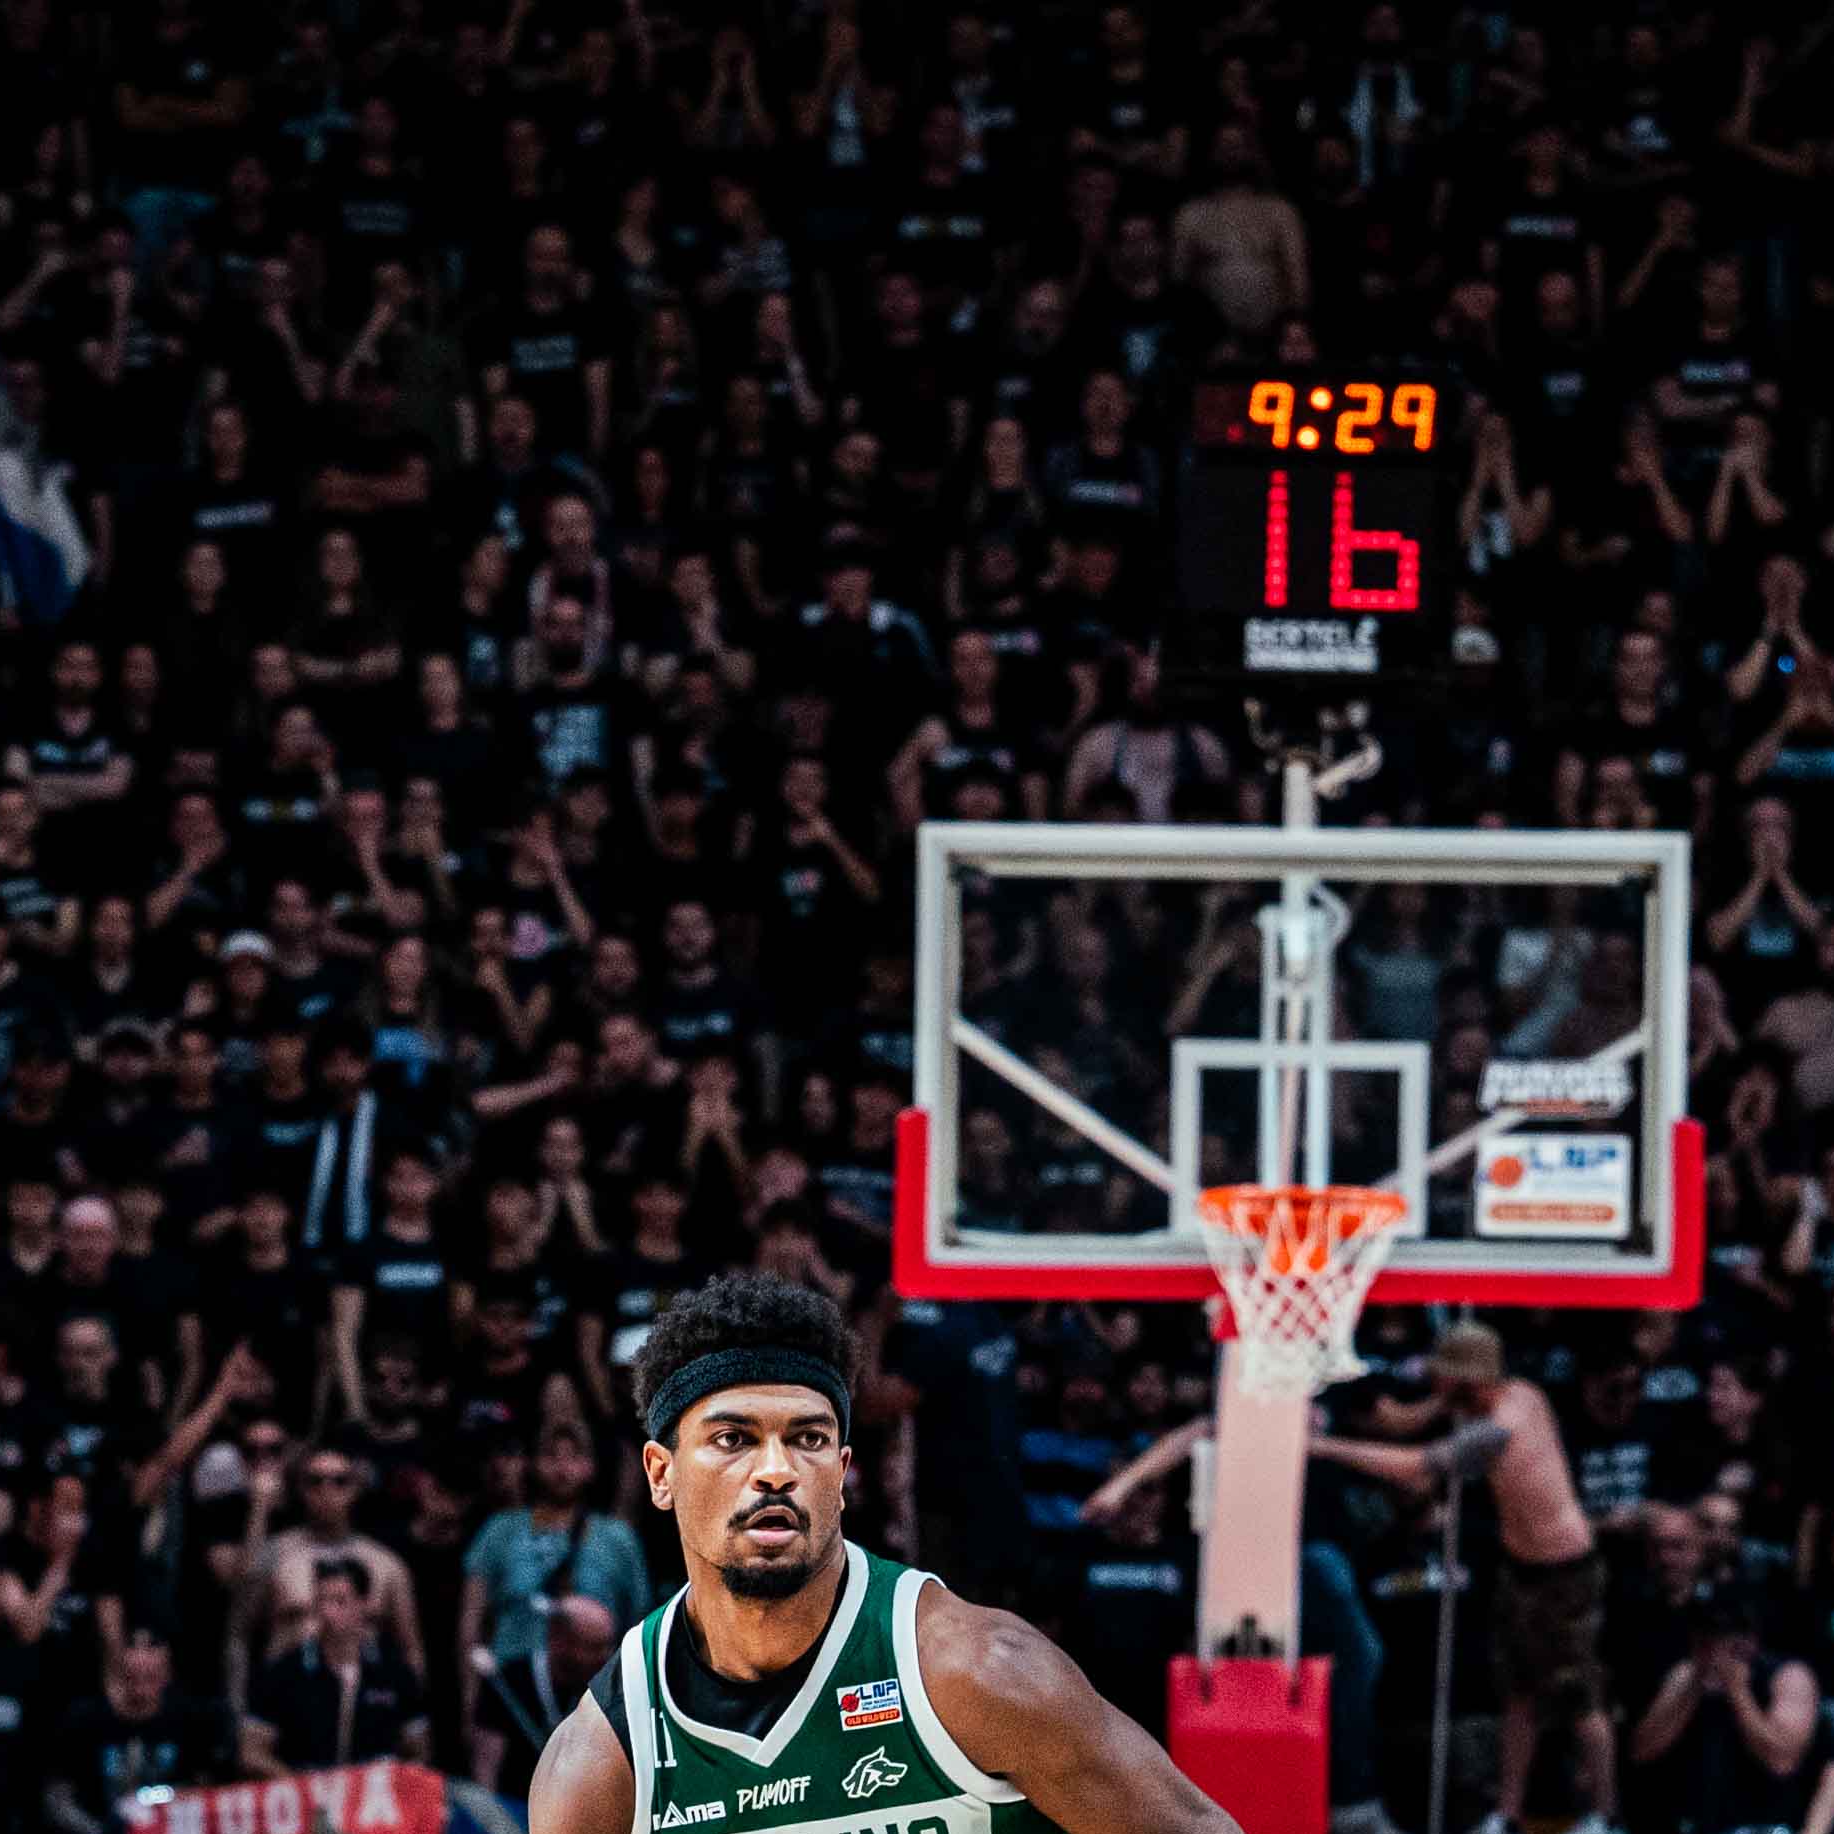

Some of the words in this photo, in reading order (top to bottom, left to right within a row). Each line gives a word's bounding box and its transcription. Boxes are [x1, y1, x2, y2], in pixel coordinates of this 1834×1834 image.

[1249, 382, 1437, 453] 9:29
[1263, 470, 1420, 611] 16
[859, 1681, 898, 1700] LNP
[736, 1775, 812, 1814] PLAYOFF
